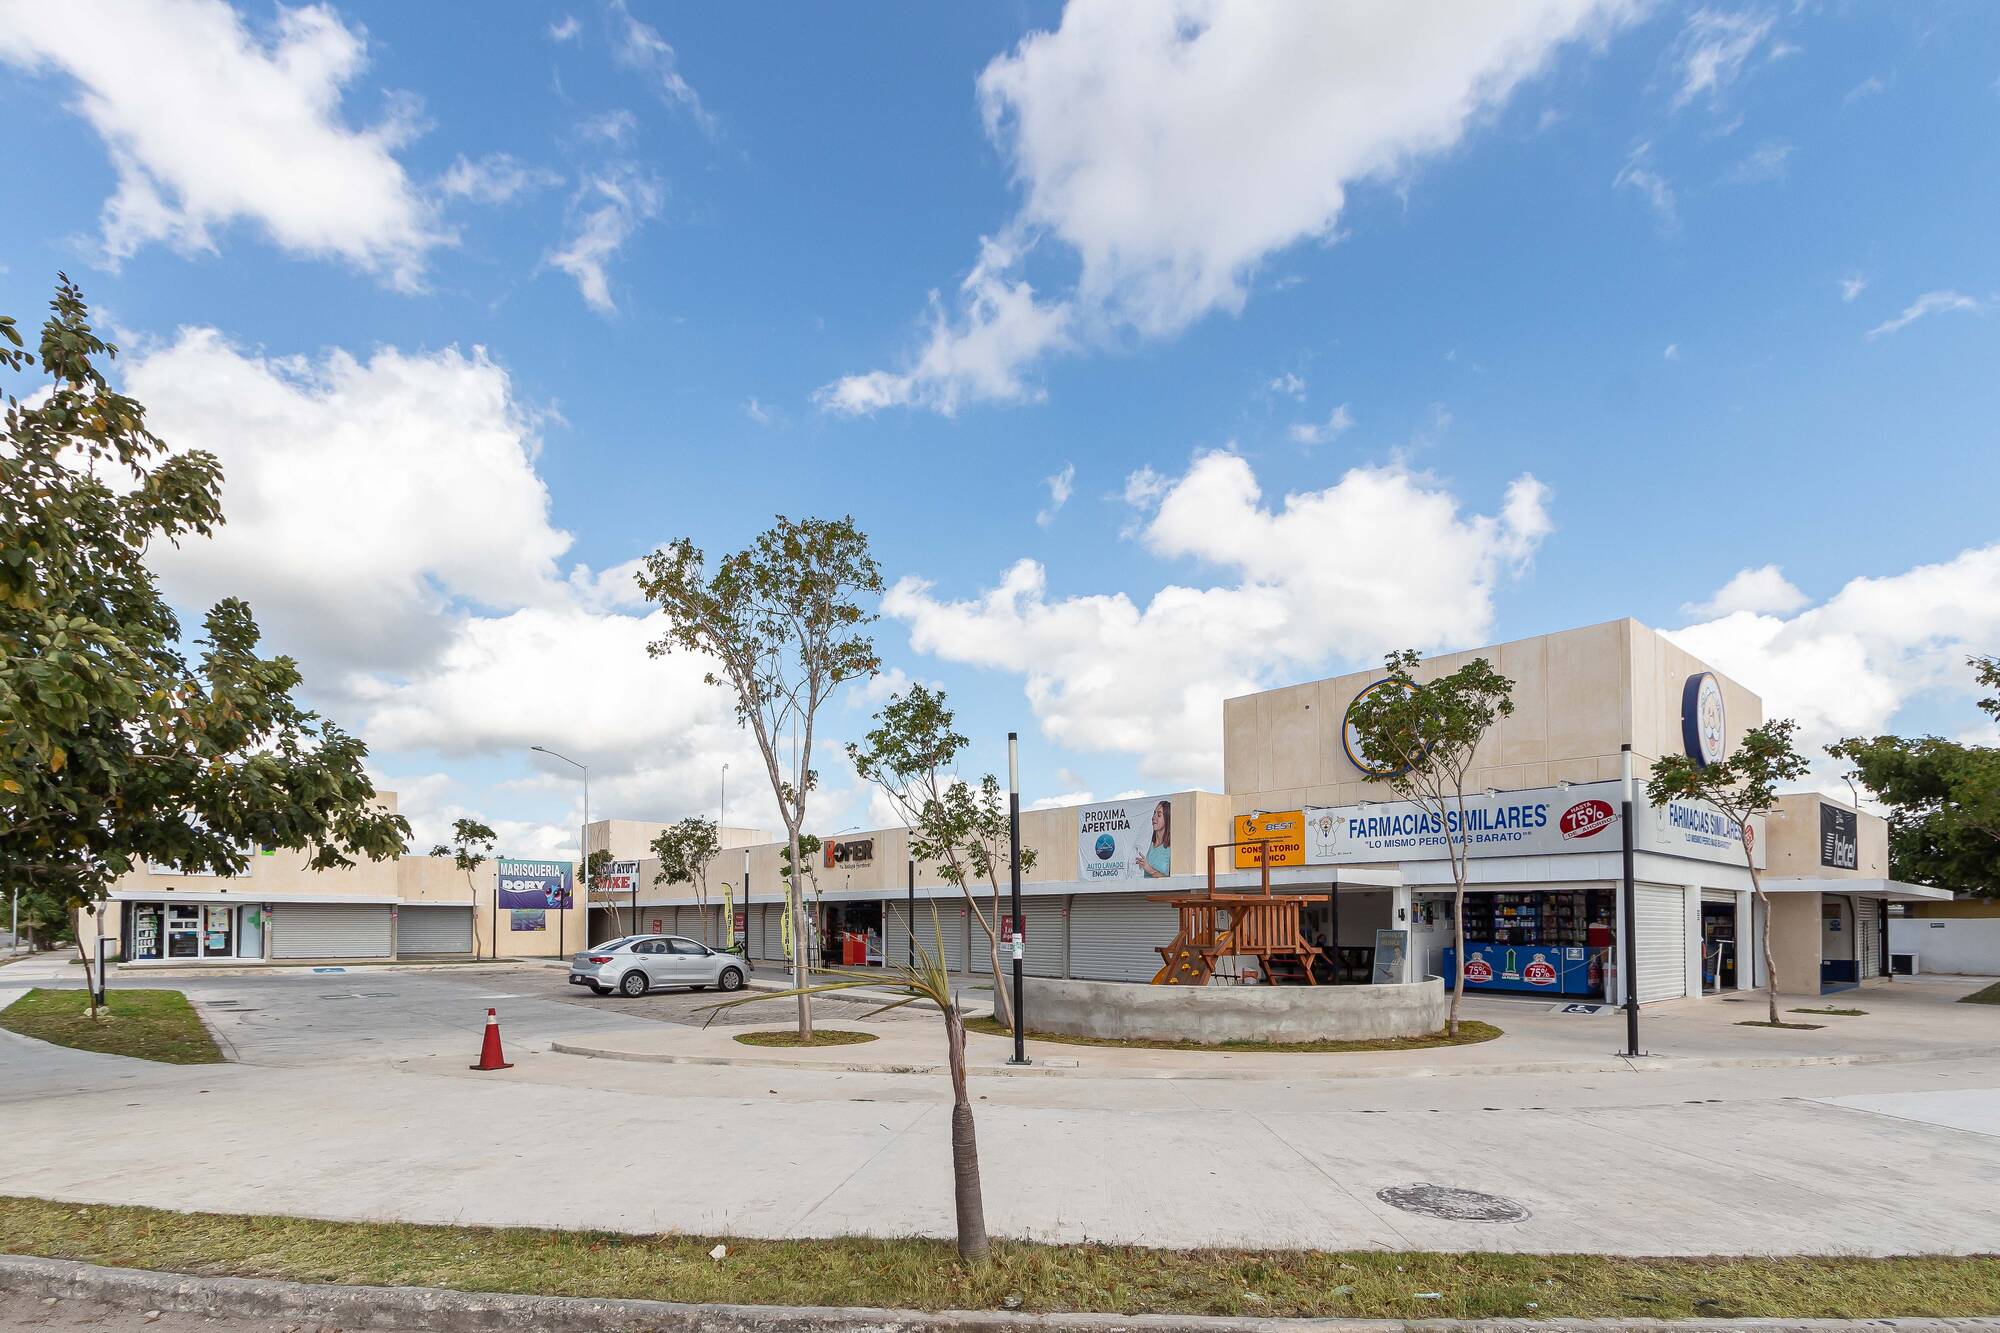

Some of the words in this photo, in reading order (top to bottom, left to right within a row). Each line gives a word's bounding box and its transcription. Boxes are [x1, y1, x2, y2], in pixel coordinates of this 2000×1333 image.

[1570, 801, 1592, 813] HASTA
[1085, 808, 1126, 822] PROXIMA
[1350, 811, 1442, 839] FARMACIAS
[1447, 803, 1547, 833] SIMILARES
[1567, 804, 1604, 829] 75%
[1669, 803, 1709, 834] FARMACIAS
[1081, 819, 1130, 833] APERTURA
[1265, 821, 1295, 831] BEST
[1567, 830, 1578, 838] DE
[1582, 817, 1613, 832] AHORRO
[1241, 843, 1300, 854] CONSLTORIO
[1384, 838, 1416, 848] MISMO
[1418, 836, 1447, 846] PERO
[824, 839, 873, 869] BOFER
[1833, 833, 1857, 868] telcel
[500, 862, 560, 877] MARISQUERIA
[1102, 861, 1124, 869] LAVADO
[1092, 869, 1119, 877] ENCARGO
[502, 879, 547, 890] DORY
[1469, 966, 1487, 976] 75%
[1530, 968, 1550, 978] 75%
